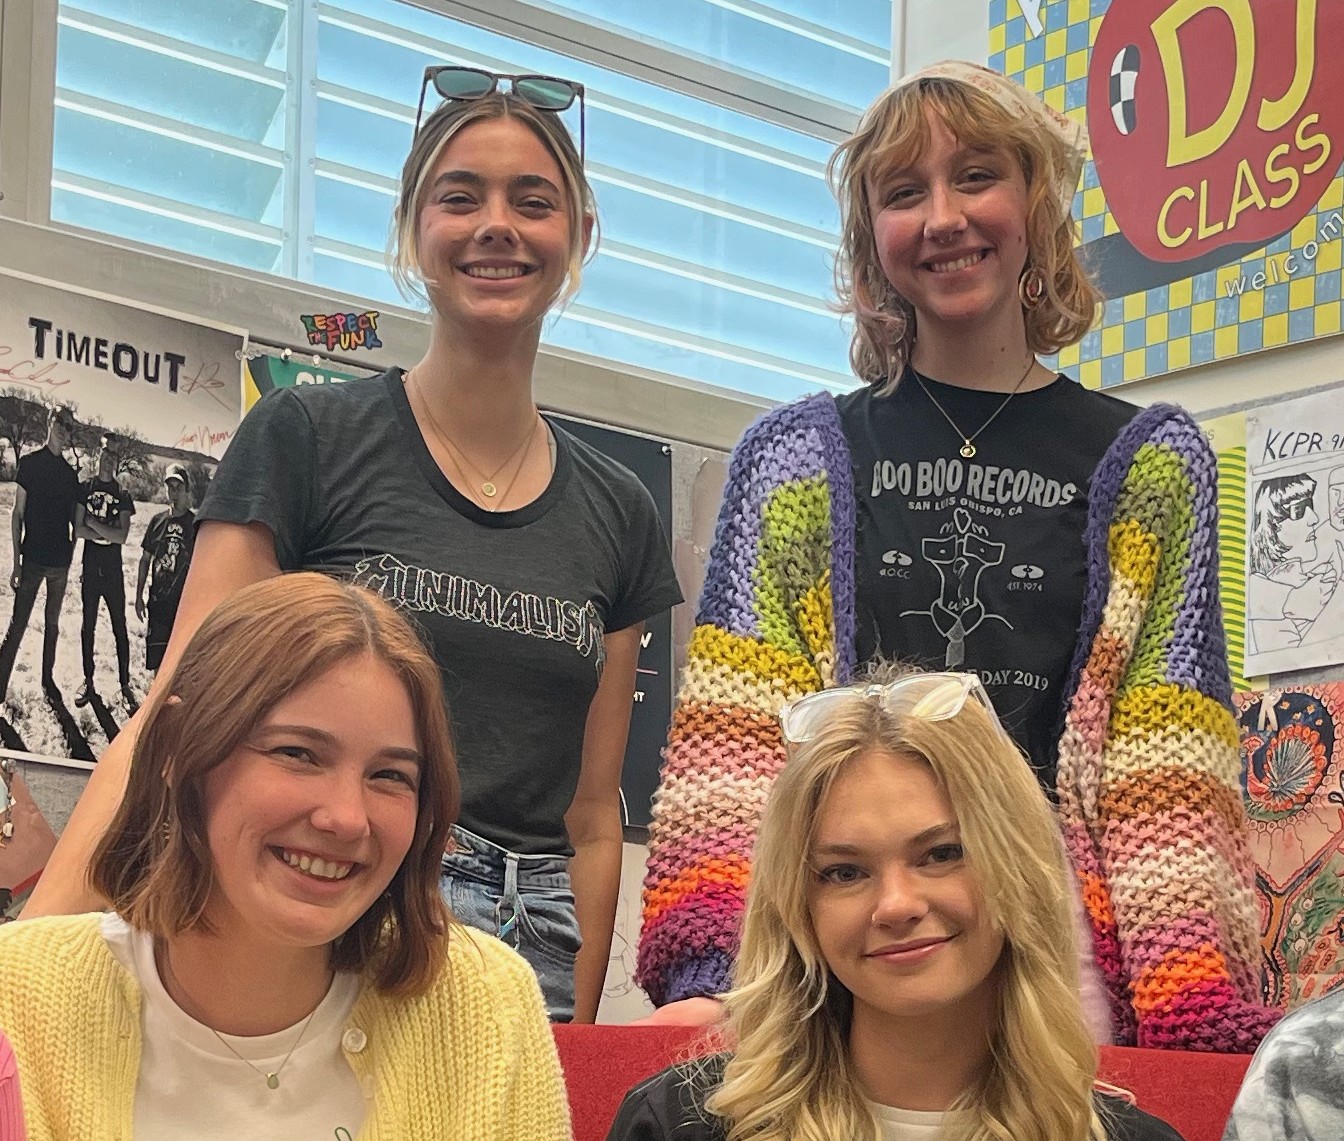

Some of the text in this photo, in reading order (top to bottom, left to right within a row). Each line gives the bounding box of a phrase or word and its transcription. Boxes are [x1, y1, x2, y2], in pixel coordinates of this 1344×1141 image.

[1150, 0, 1316, 167] DJ
[1157, 114, 1331, 248] CLASS
[300, 311, 379, 332] RESPECT
[326, 330, 382, 351] FUNK
[1263, 428, 1322, 465] KCPR
[871, 458, 1077, 508] BOO BOO RECORDS
[908, 501, 931, 511] SAN
[935, 496, 956, 511] LUIS
[1008, 506, 1023, 516] CA
[981, 671, 1009, 685] DAY
[1013, 671, 1049, 690] 2019
